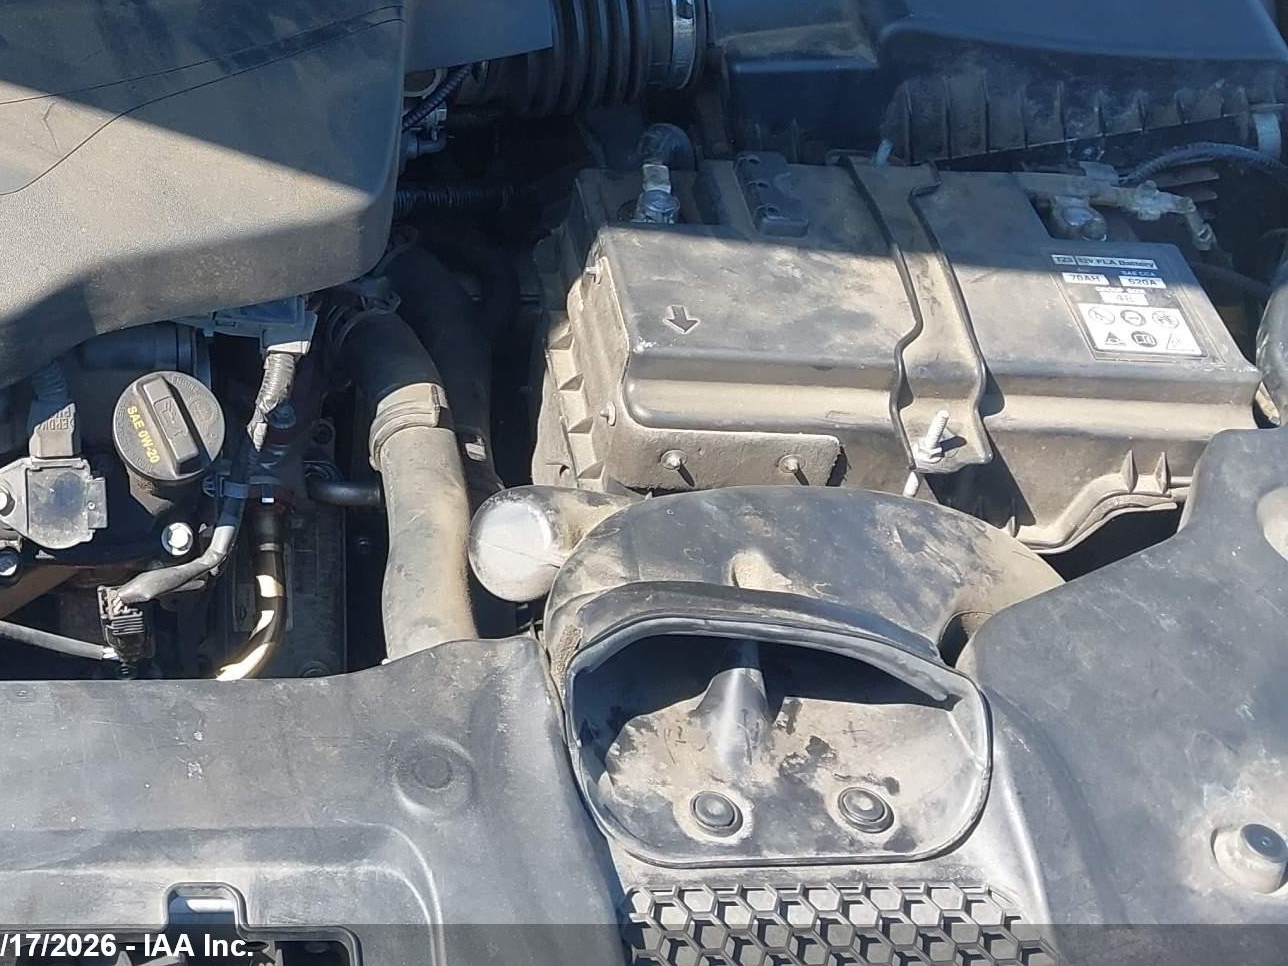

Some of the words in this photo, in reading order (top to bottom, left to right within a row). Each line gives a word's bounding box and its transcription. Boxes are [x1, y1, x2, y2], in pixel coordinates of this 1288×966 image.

[1119, 260, 1155, 269] Battery
[1069, 274, 1101, 282] 70AH
[1127, 278, 1158, 286] 520A
[126, 405, 145, 430] SAE
[137, 429, 161, 464] 0W-20
